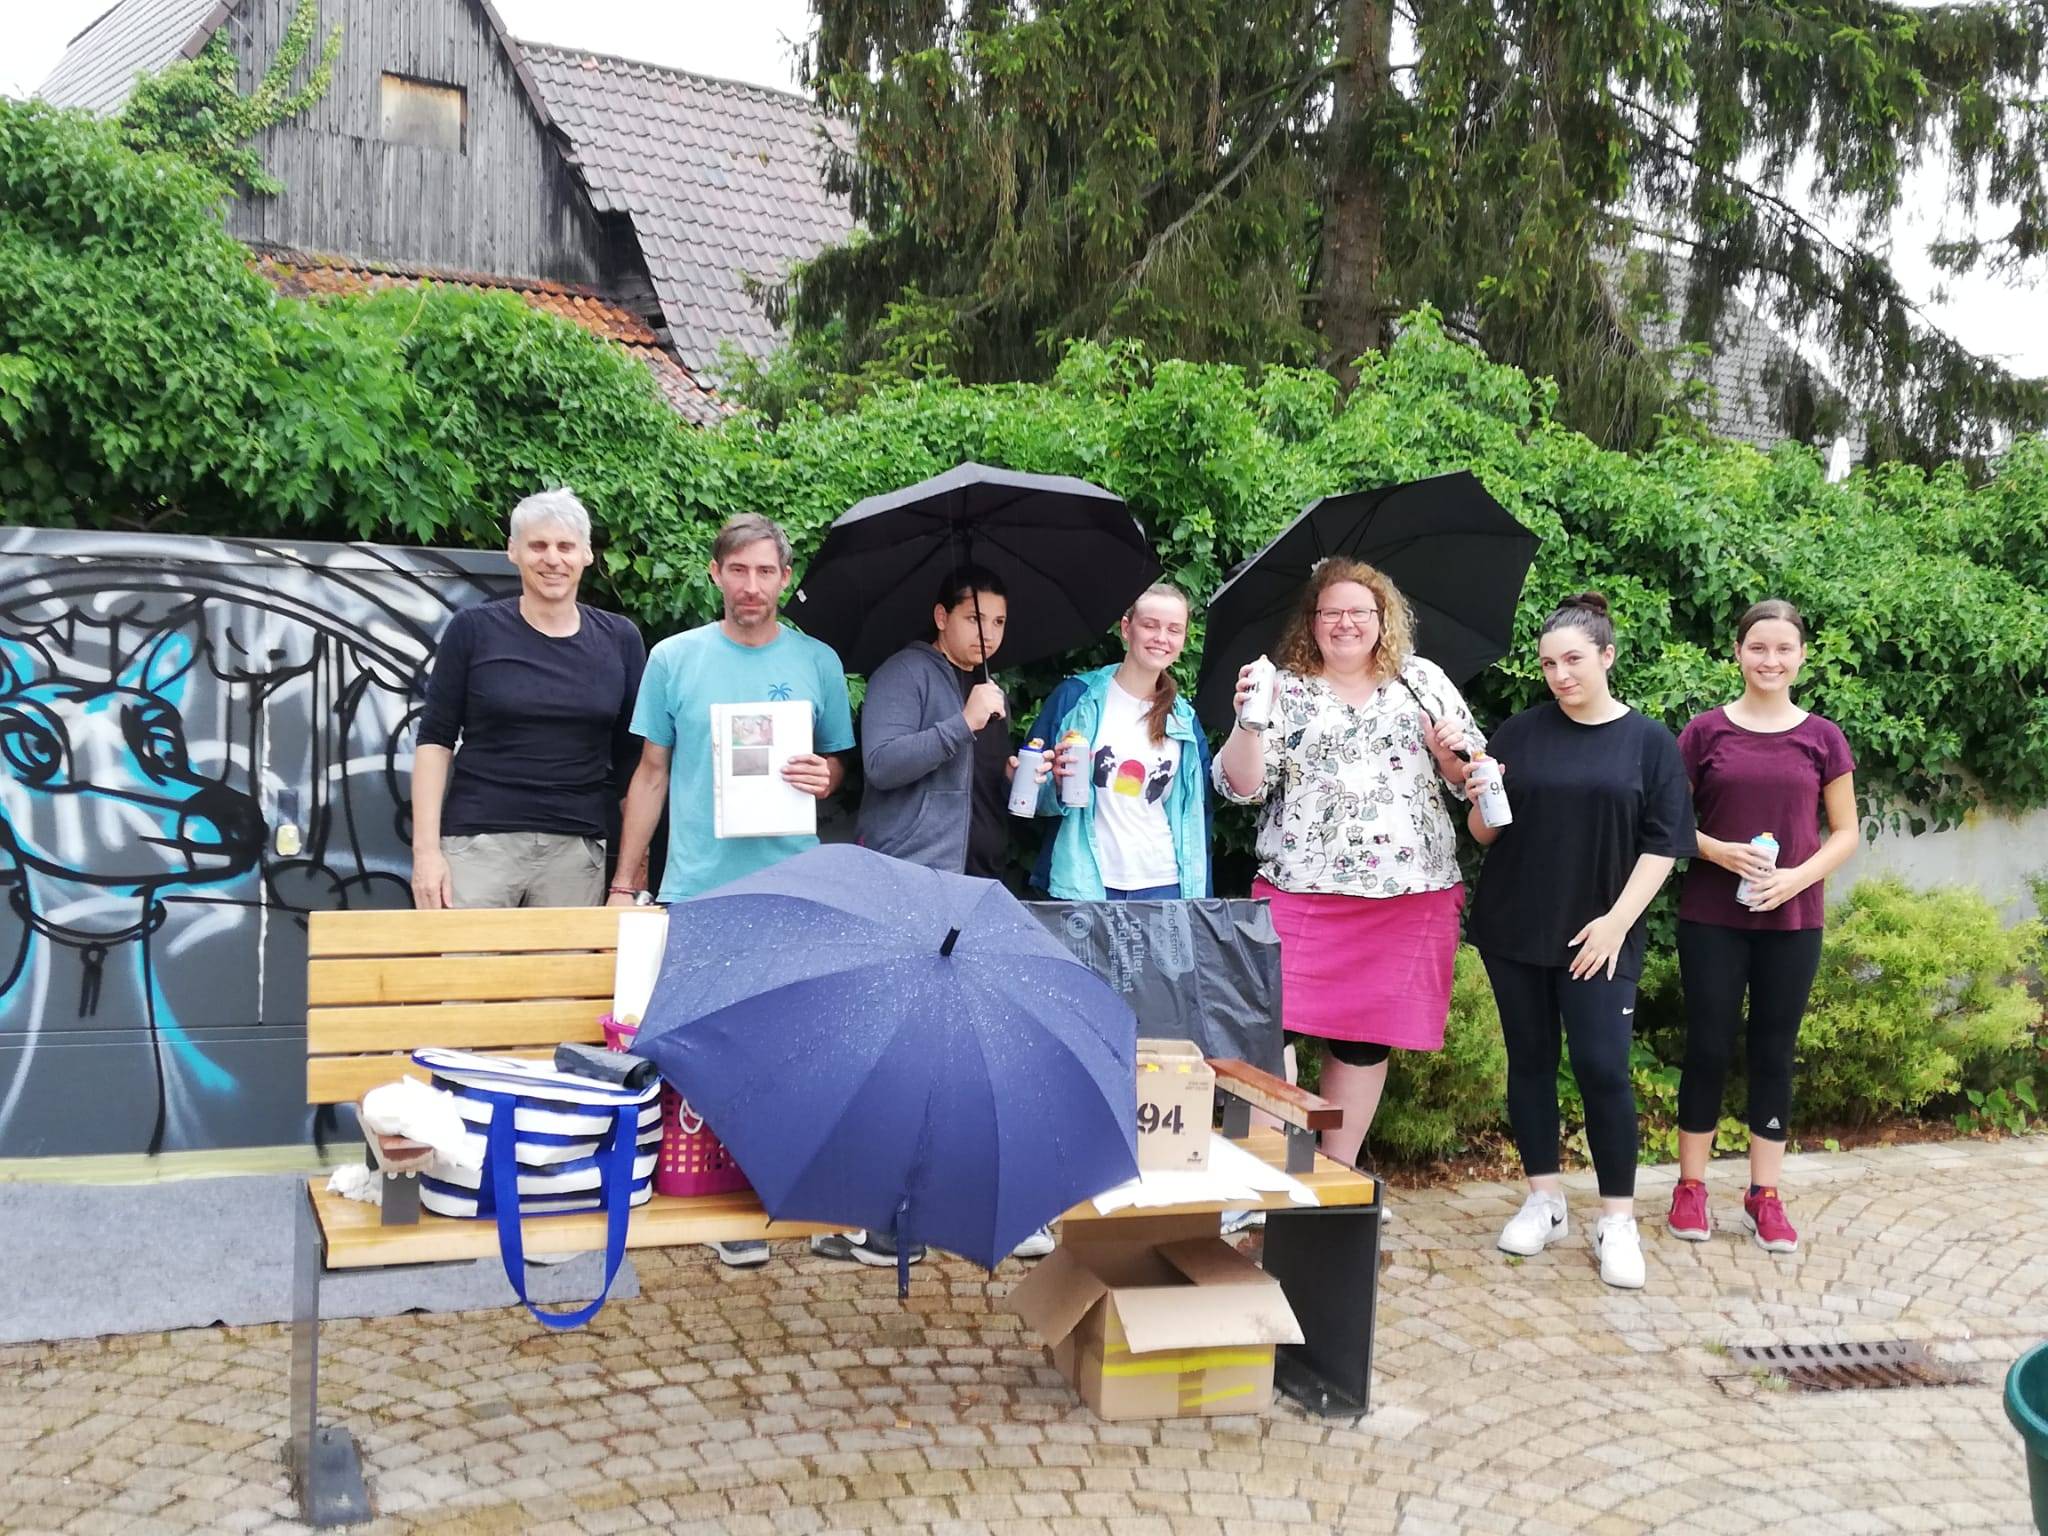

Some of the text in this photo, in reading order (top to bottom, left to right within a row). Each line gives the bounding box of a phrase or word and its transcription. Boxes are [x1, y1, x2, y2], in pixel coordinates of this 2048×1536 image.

[1116, 921, 1134, 993] Schwerlast
[1130, 918, 1145, 974] 120 Liter
[1137, 1102, 1184, 1135] 94
